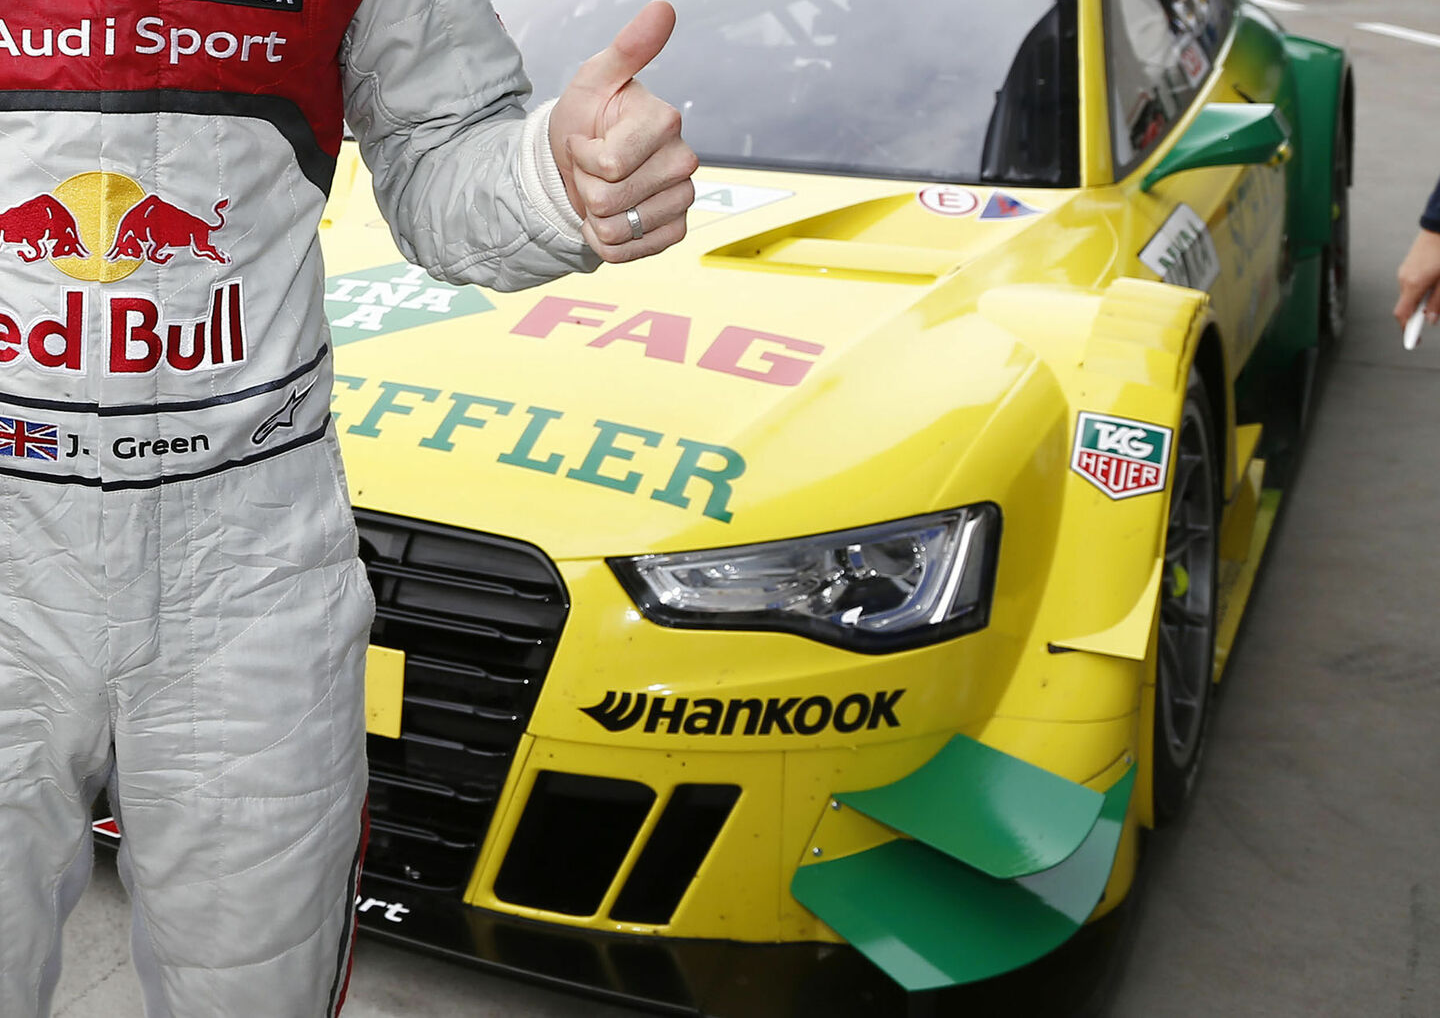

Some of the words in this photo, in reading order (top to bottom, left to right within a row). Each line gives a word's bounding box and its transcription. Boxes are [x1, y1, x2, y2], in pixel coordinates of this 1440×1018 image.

[134, 16, 288, 65] Sport
[109, 282, 246, 374] Bull
[509, 295, 826, 387] FAG
[64, 433, 90, 459] J.
[112, 433, 211, 460] Green
[333, 375, 747, 525] FFLER
[1094, 421, 1154, 459] TAG
[1080, 452, 1158, 492] HEUER
